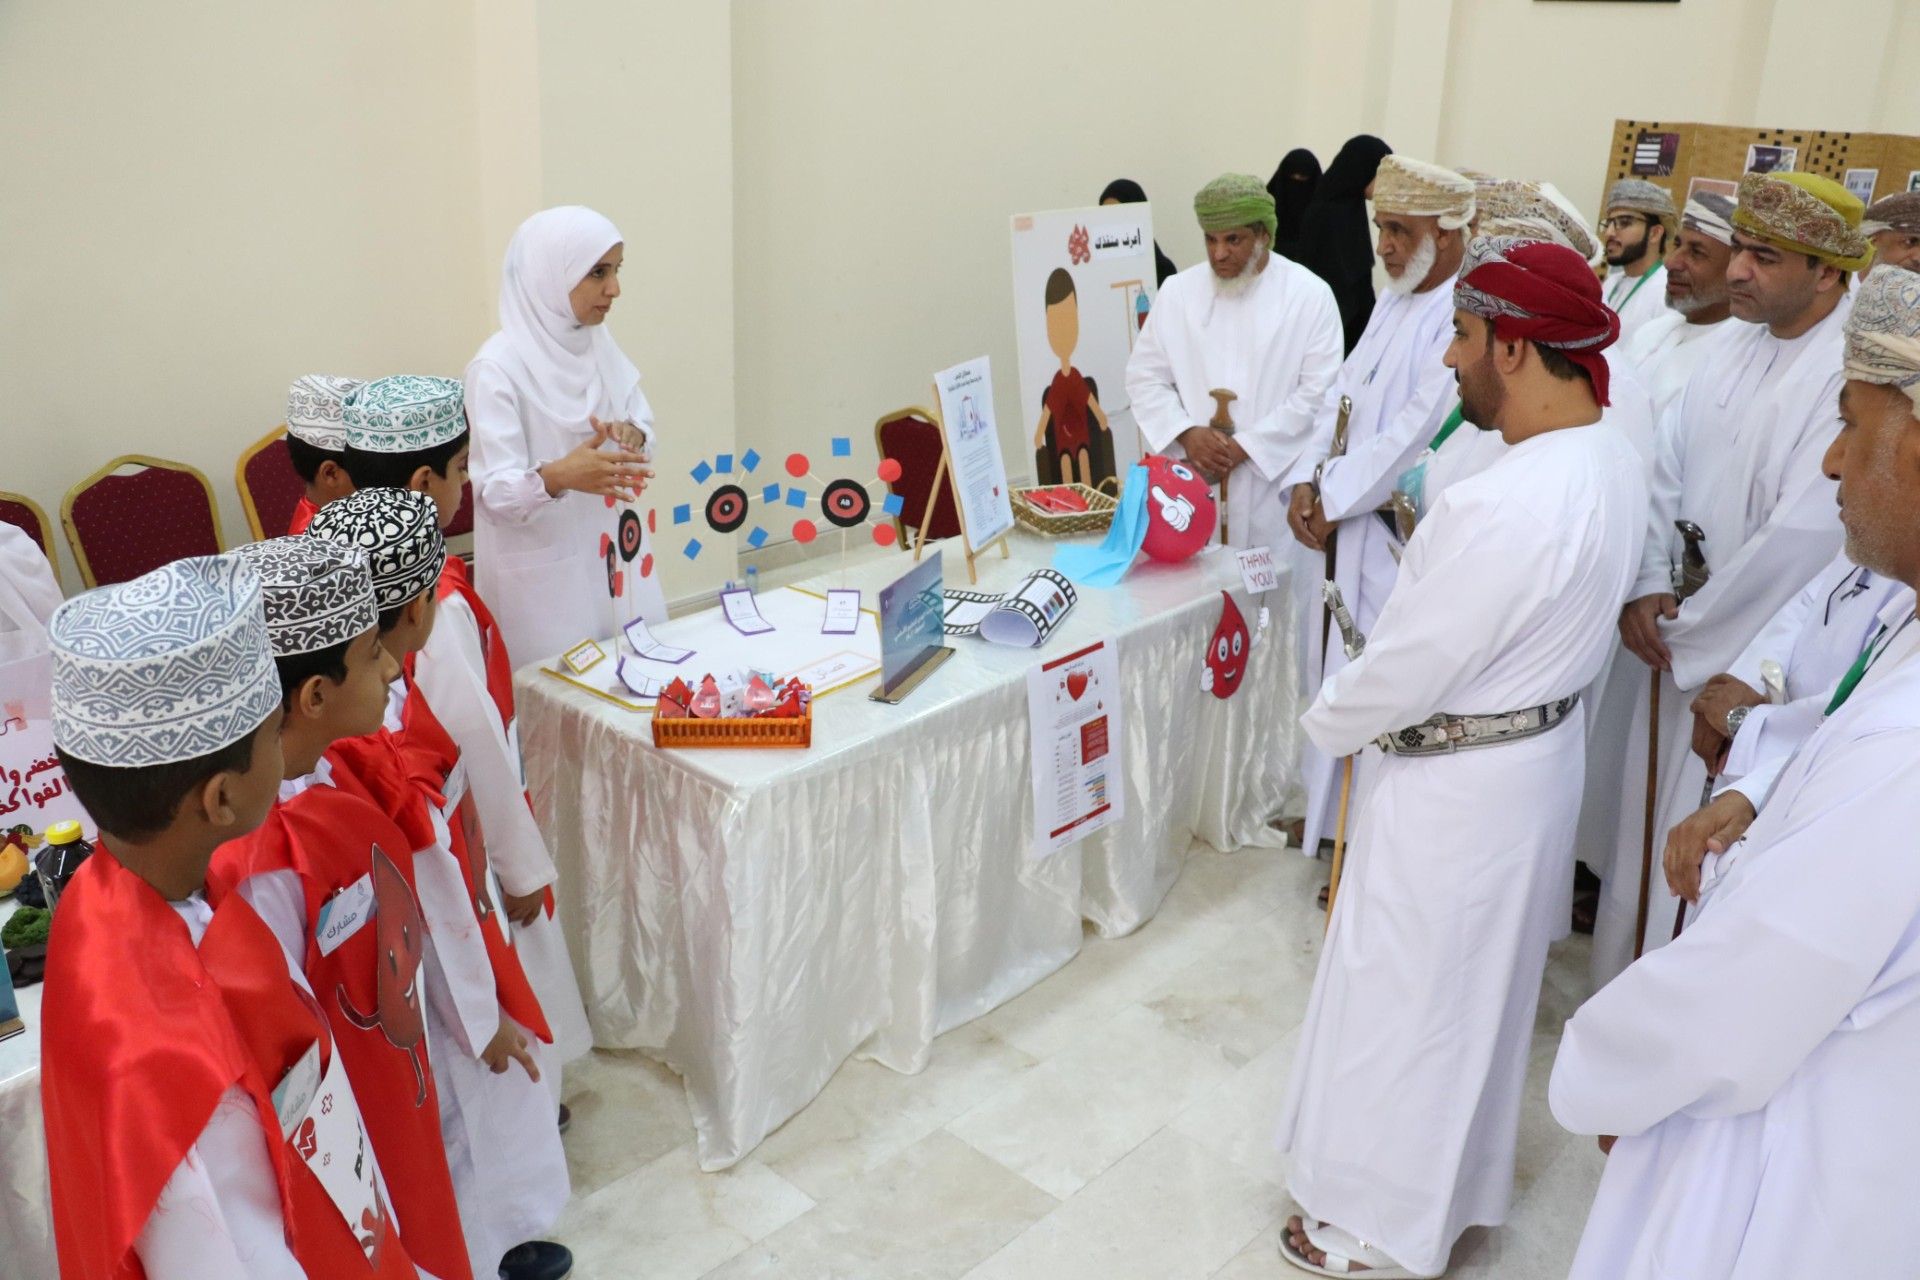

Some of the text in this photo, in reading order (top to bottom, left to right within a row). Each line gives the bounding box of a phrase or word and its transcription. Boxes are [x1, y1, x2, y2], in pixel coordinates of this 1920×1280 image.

[1239, 553, 1272, 570] THANK
[1249, 570, 1274, 587] YOU!
[326, 912, 357, 938] مشارك
